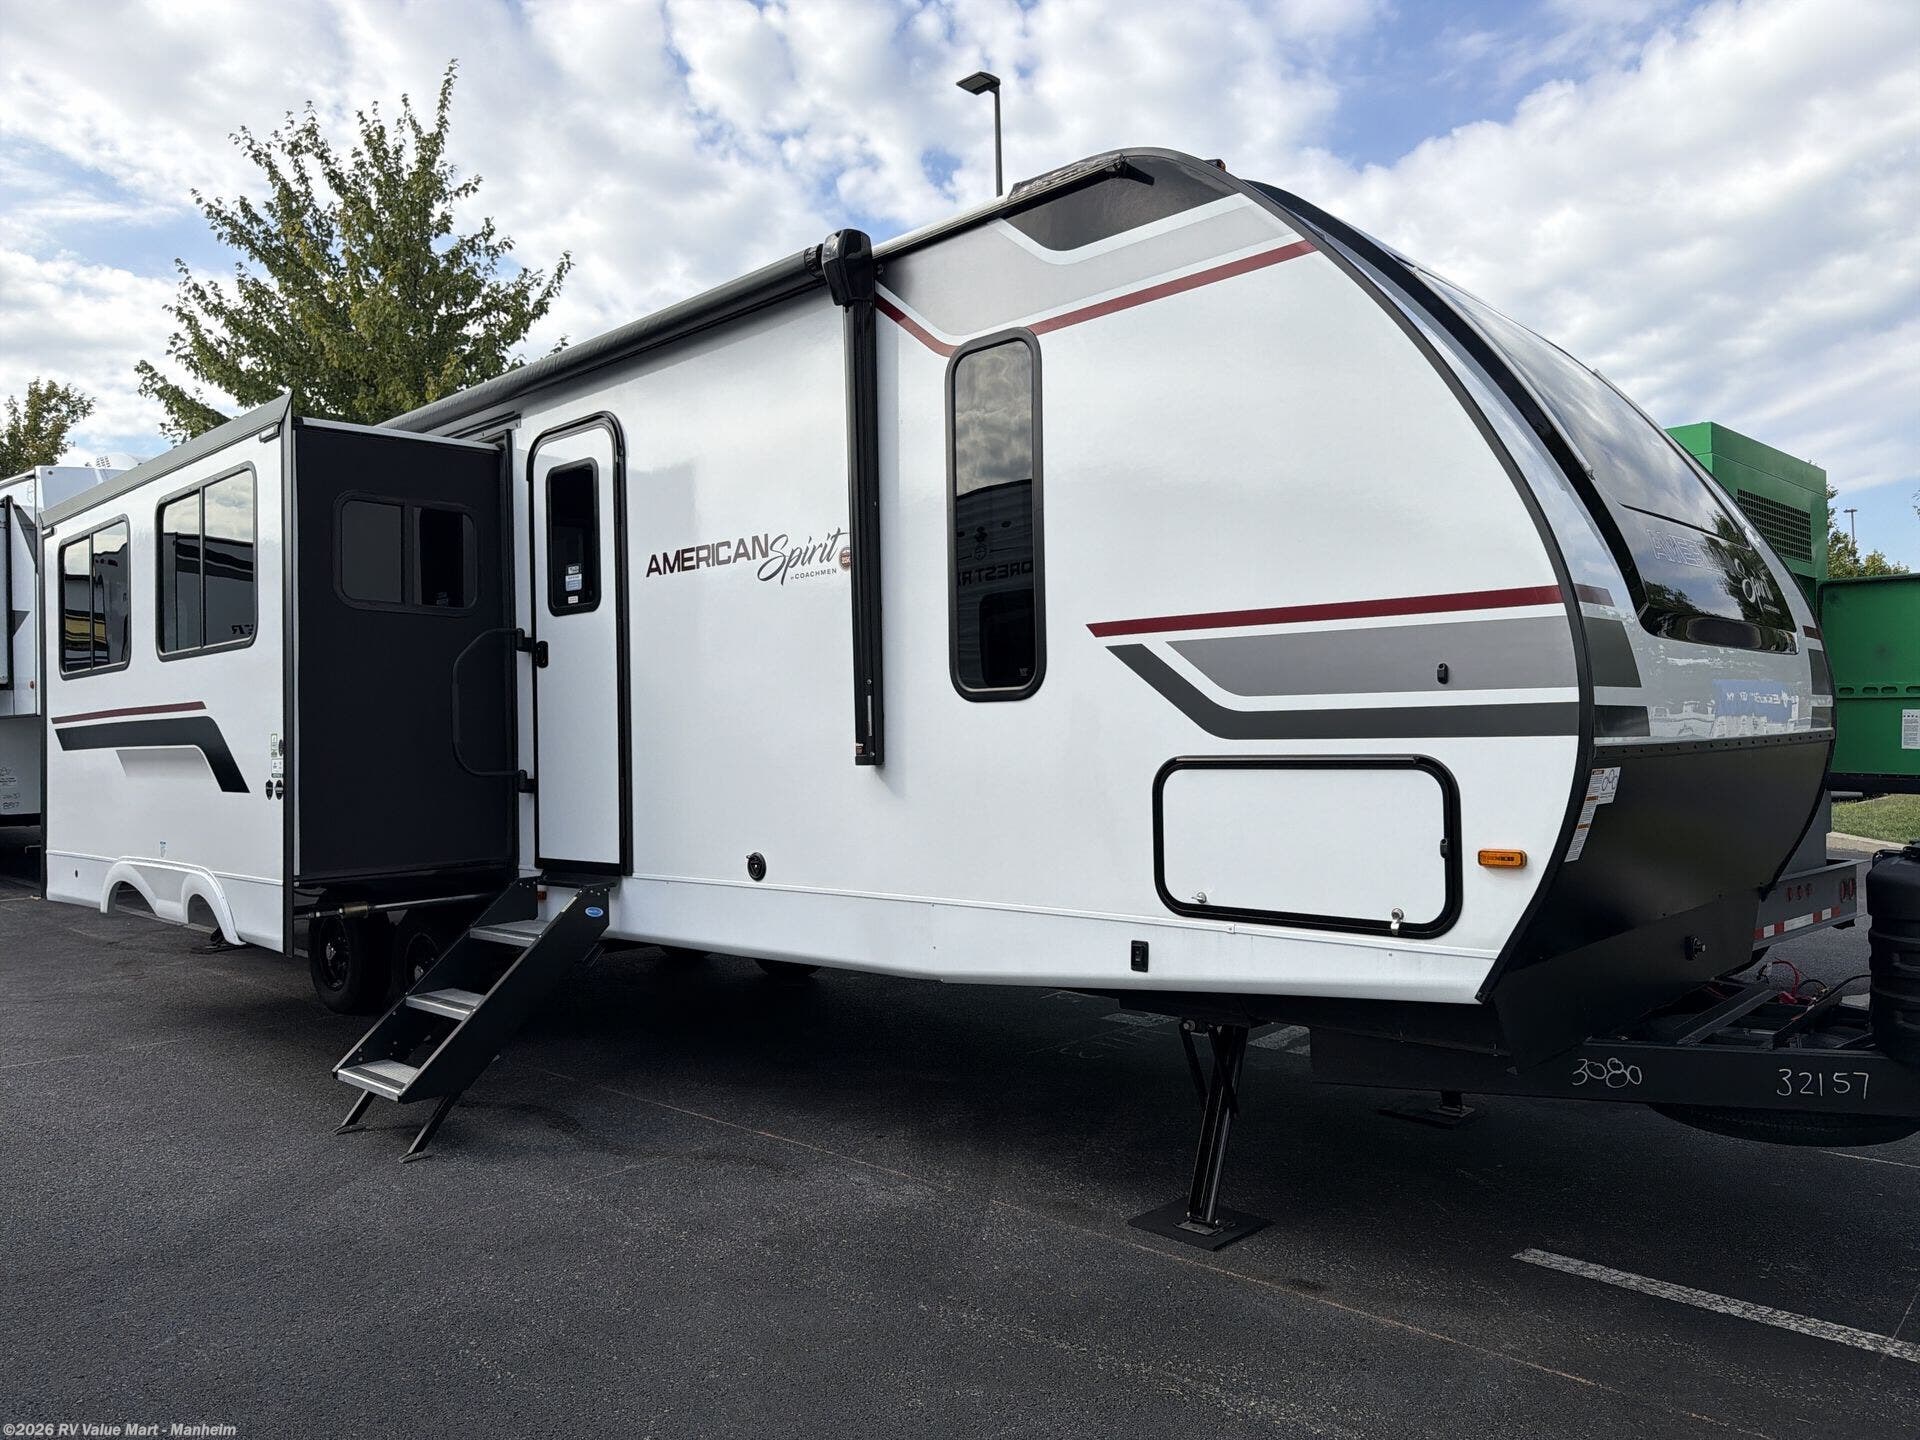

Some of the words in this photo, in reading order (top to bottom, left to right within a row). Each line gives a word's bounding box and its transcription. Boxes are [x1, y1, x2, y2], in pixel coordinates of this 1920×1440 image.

[646, 533, 769, 578] AMERICAN
[757, 527, 850, 586] Spirit
[795, 568, 837, 580] COACHMEN
[1572, 1057, 1643, 1089] 3080
[1776, 1068, 1870, 1099] 32157
